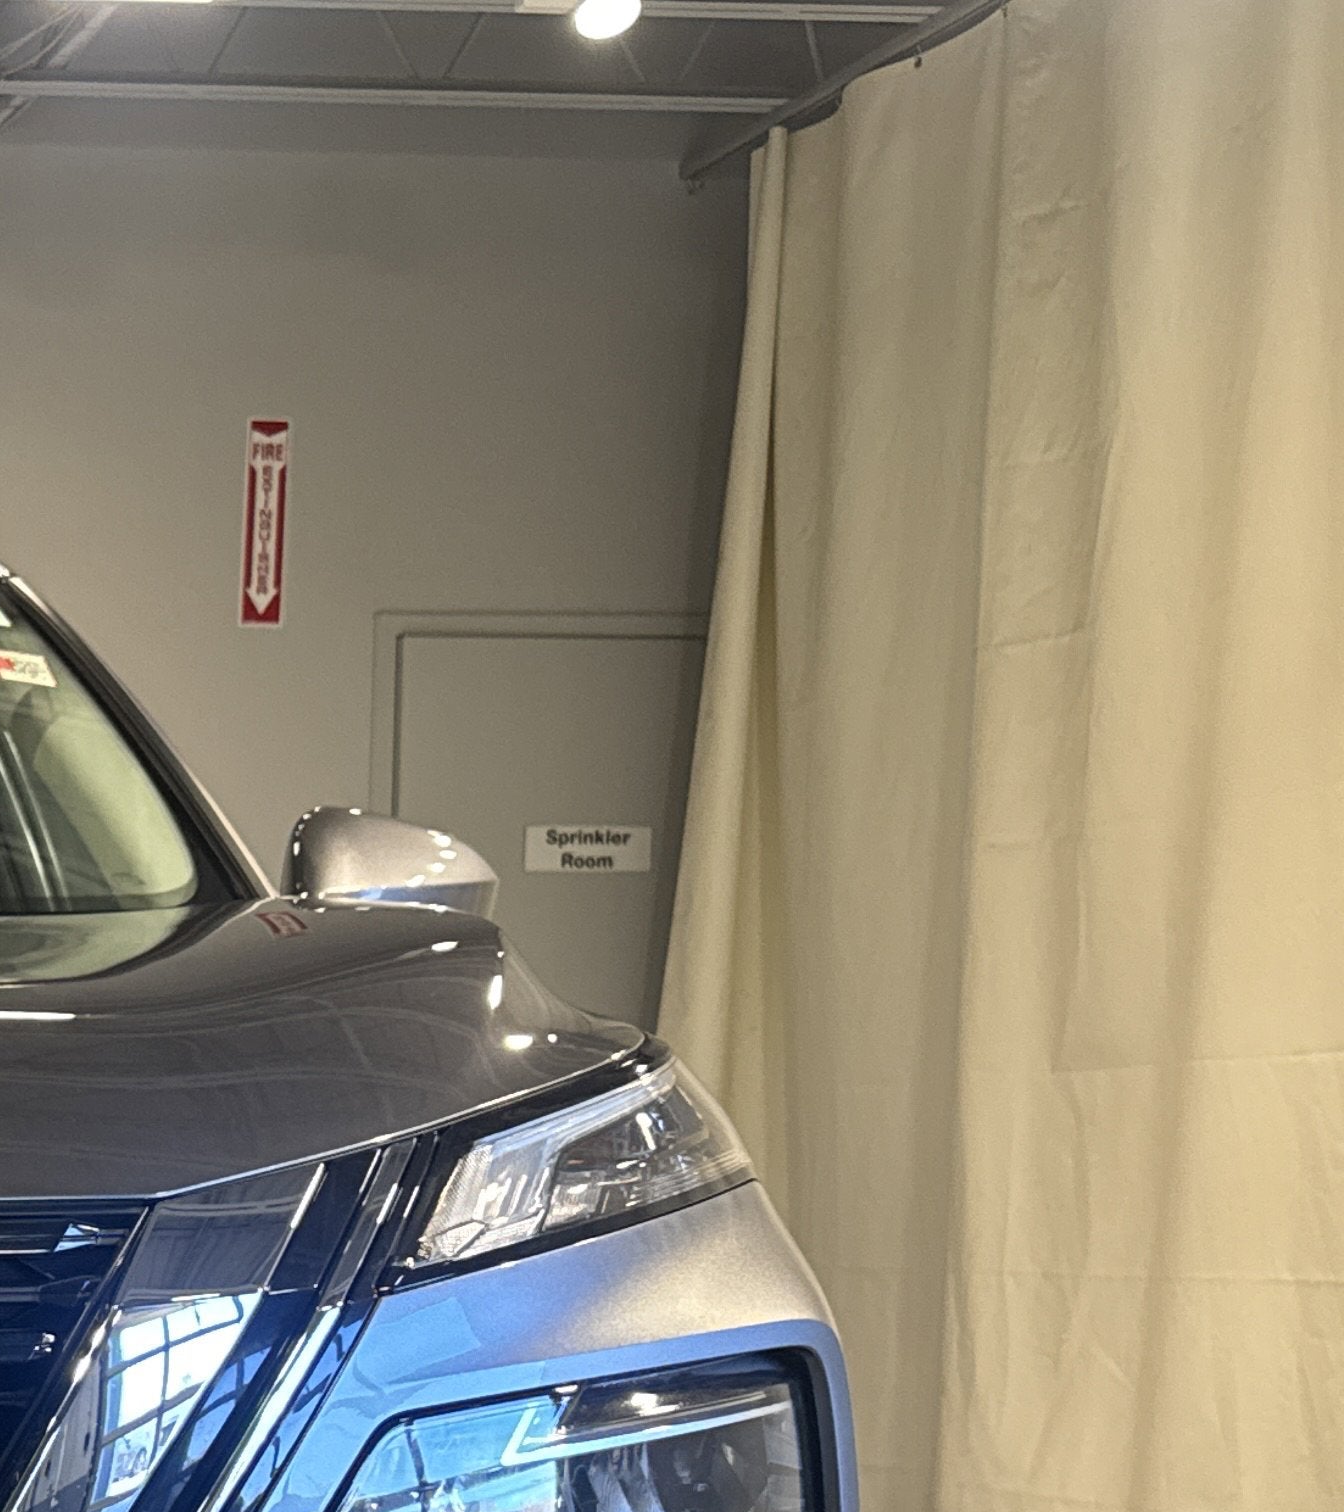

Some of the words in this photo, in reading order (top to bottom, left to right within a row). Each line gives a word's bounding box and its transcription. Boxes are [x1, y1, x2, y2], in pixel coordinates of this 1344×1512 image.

[252, 443, 283, 461] FIRE
[545, 829, 631, 848] Sprinkler
[560, 853, 615, 868] Room
